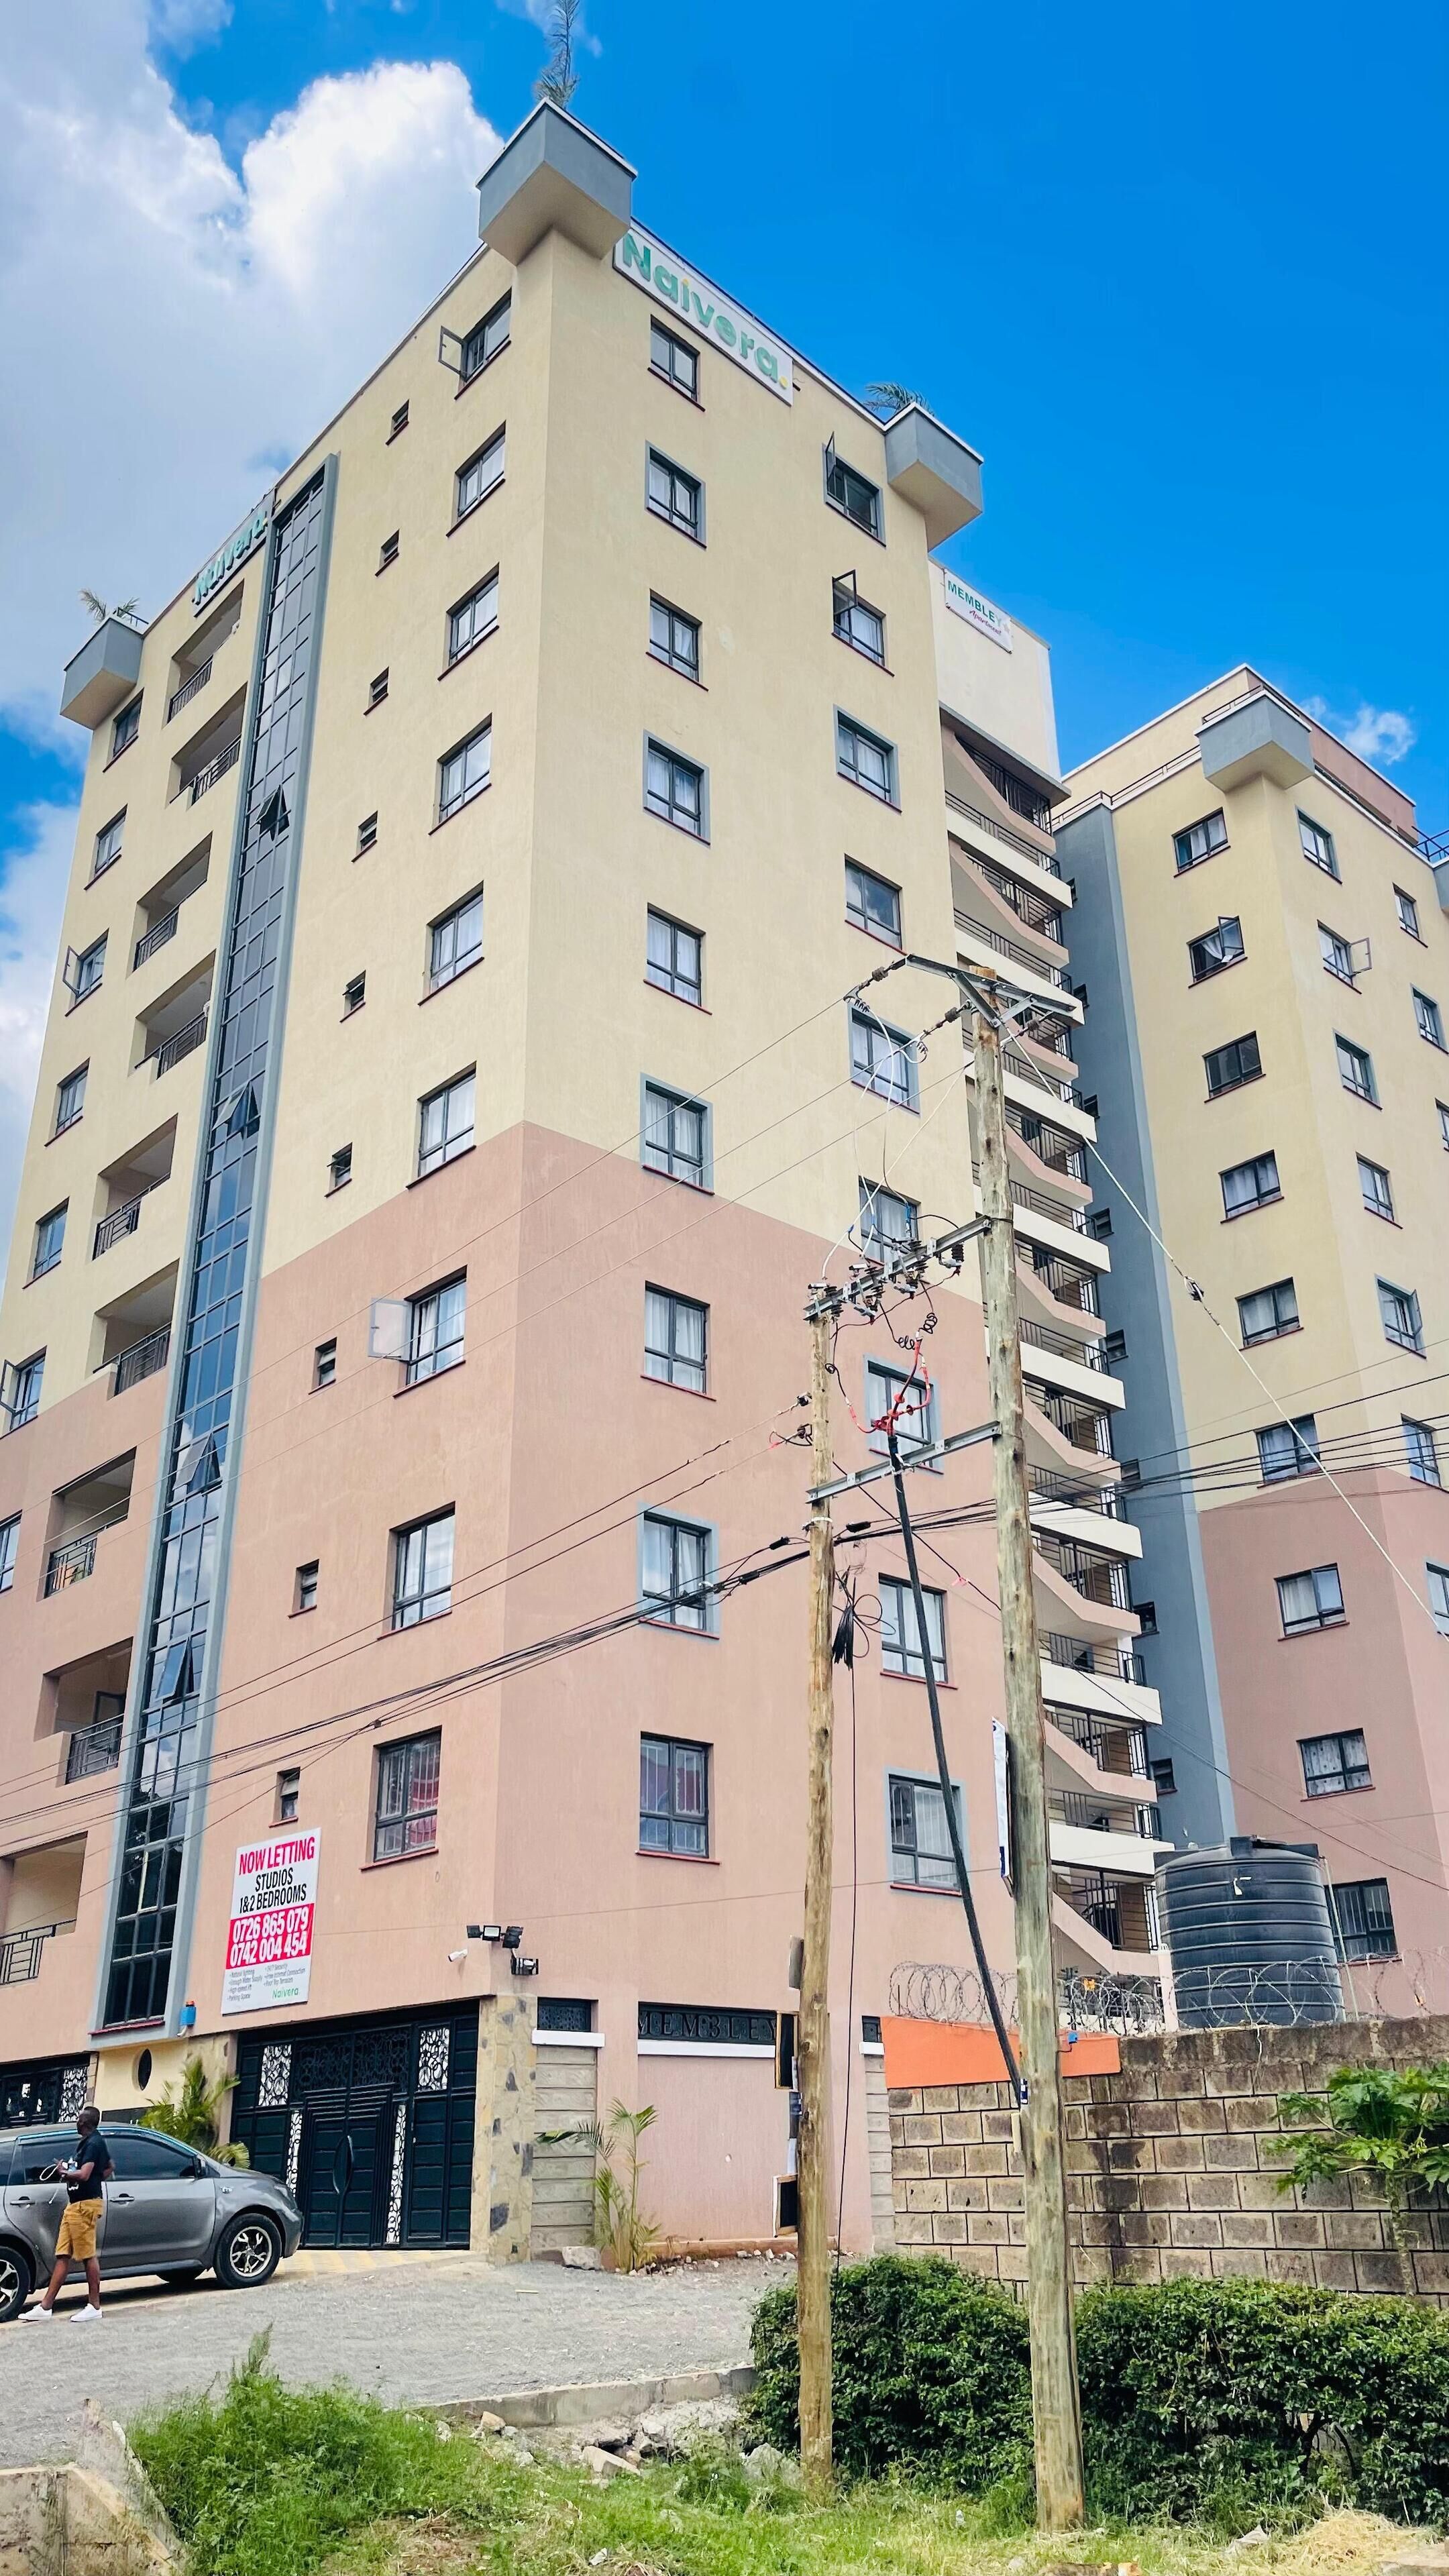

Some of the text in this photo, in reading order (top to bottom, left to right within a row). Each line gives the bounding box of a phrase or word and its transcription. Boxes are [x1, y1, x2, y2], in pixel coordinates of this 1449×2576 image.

[239, 1836, 315, 1876] NOW LETTING
[255, 1867, 293, 1892] STUDIOS
[239, 1883, 307, 1914] 1&2 BEDROOMS
[232, 1906, 309, 1943] 0726 865 079
[229, 1930, 307, 1967] 0742 004 454
